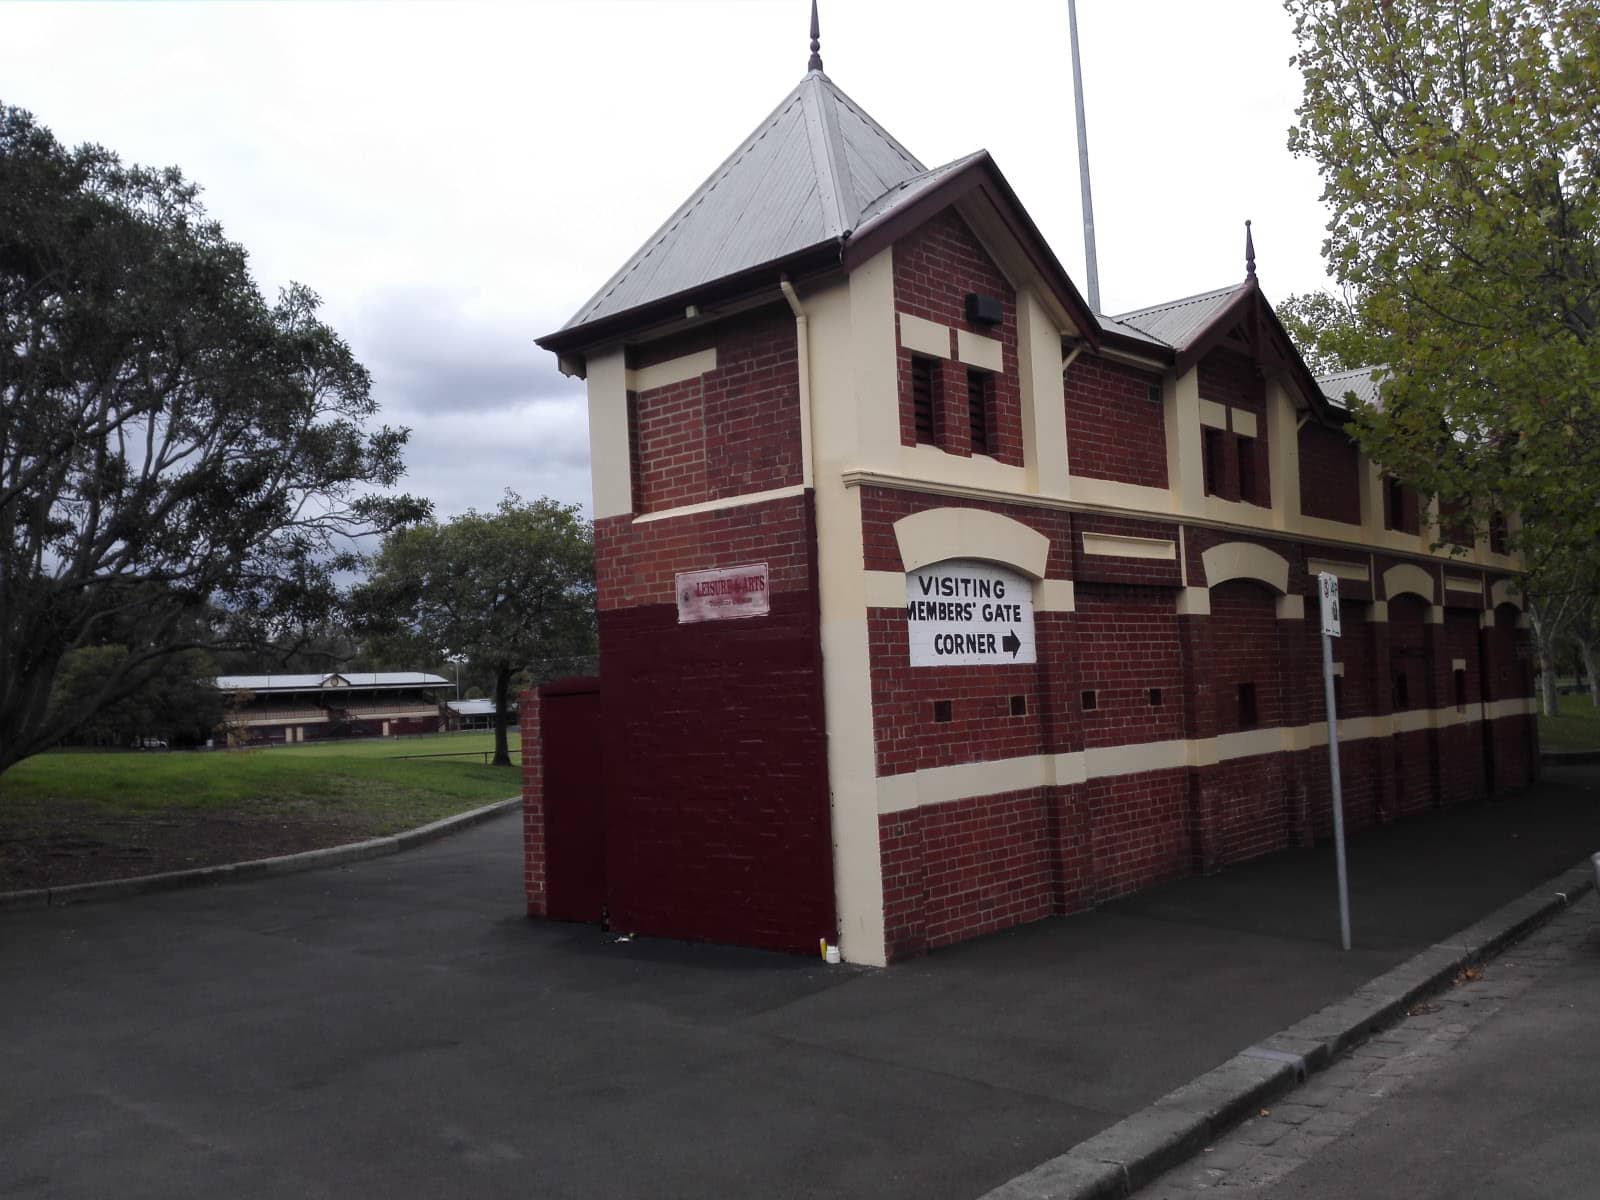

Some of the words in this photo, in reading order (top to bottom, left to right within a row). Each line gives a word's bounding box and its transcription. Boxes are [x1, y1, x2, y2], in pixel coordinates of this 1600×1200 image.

[918, 576, 1005, 599] VISITING
[906, 600, 977, 621] MEMBERS'
[982, 603, 1022, 623] GATE
[934, 633, 997, 655] CORNER
